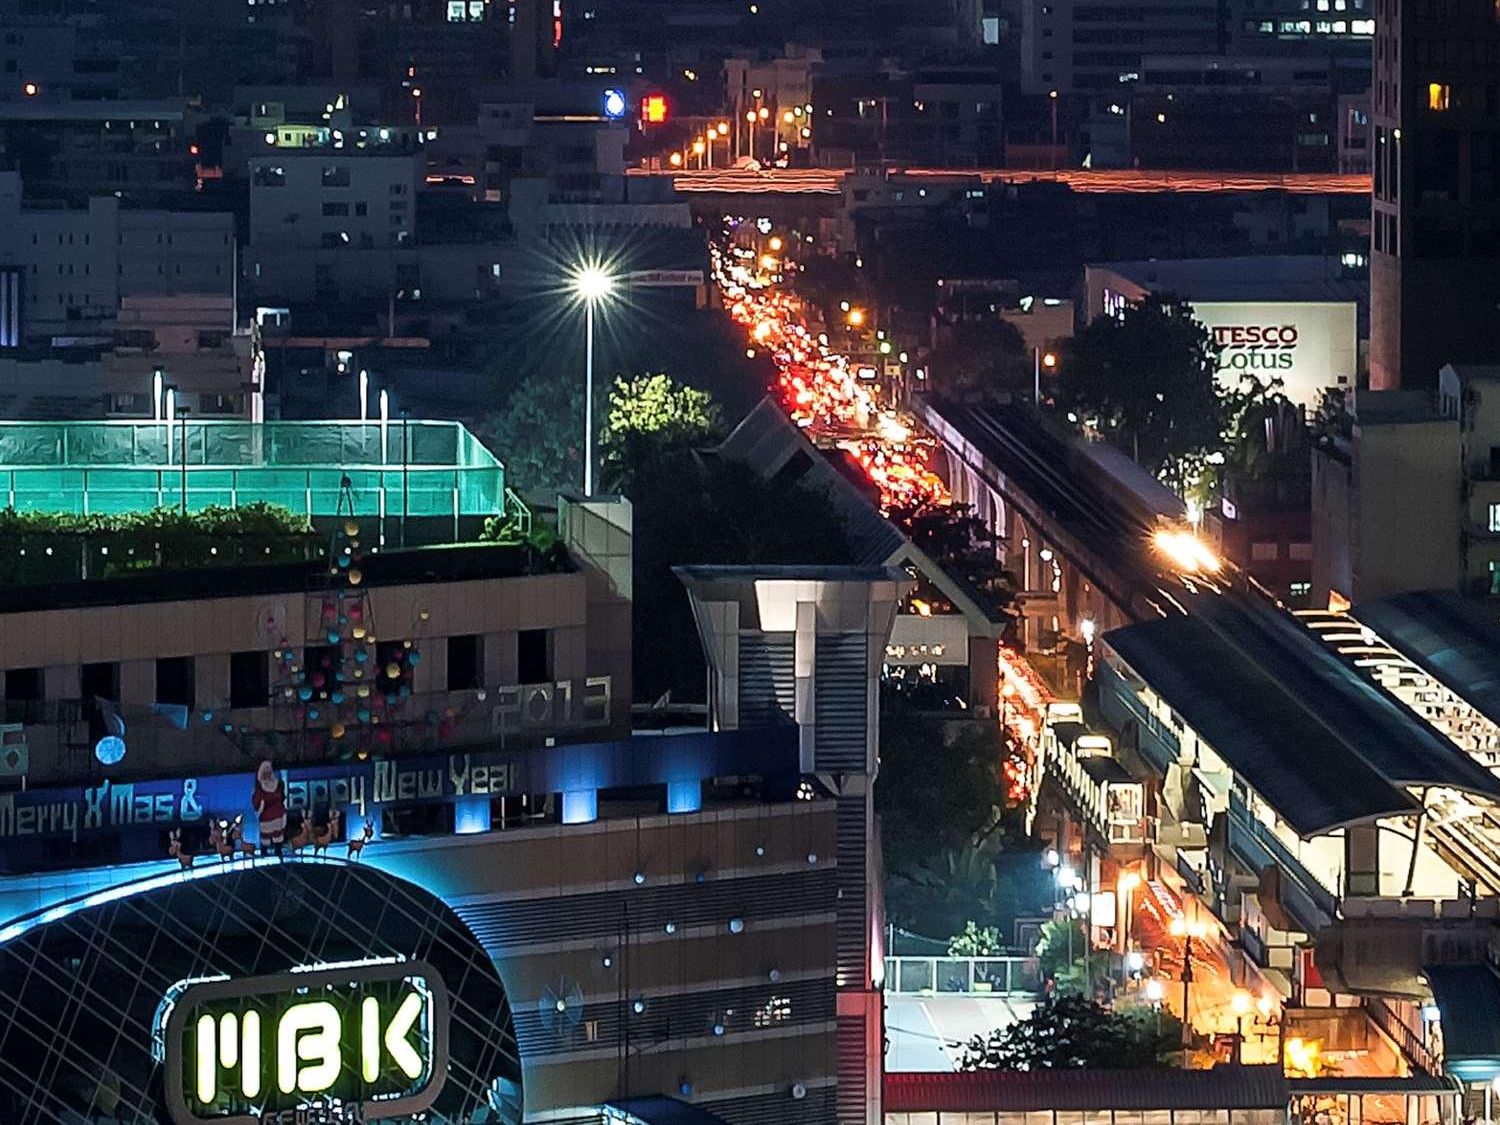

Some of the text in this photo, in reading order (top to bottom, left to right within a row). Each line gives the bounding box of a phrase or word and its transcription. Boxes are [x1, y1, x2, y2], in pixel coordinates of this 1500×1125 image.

[1212, 326, 1298, 343] TESCO
[1215, 349, 1293, 369] Lotus
[493, 674, 612, 732] 2013
[180, 778, 202, 821] &
[373, 758, 443, 803] New
[450, 753, 517, 796] Year
[197, 991, 424, 1104] MBK
